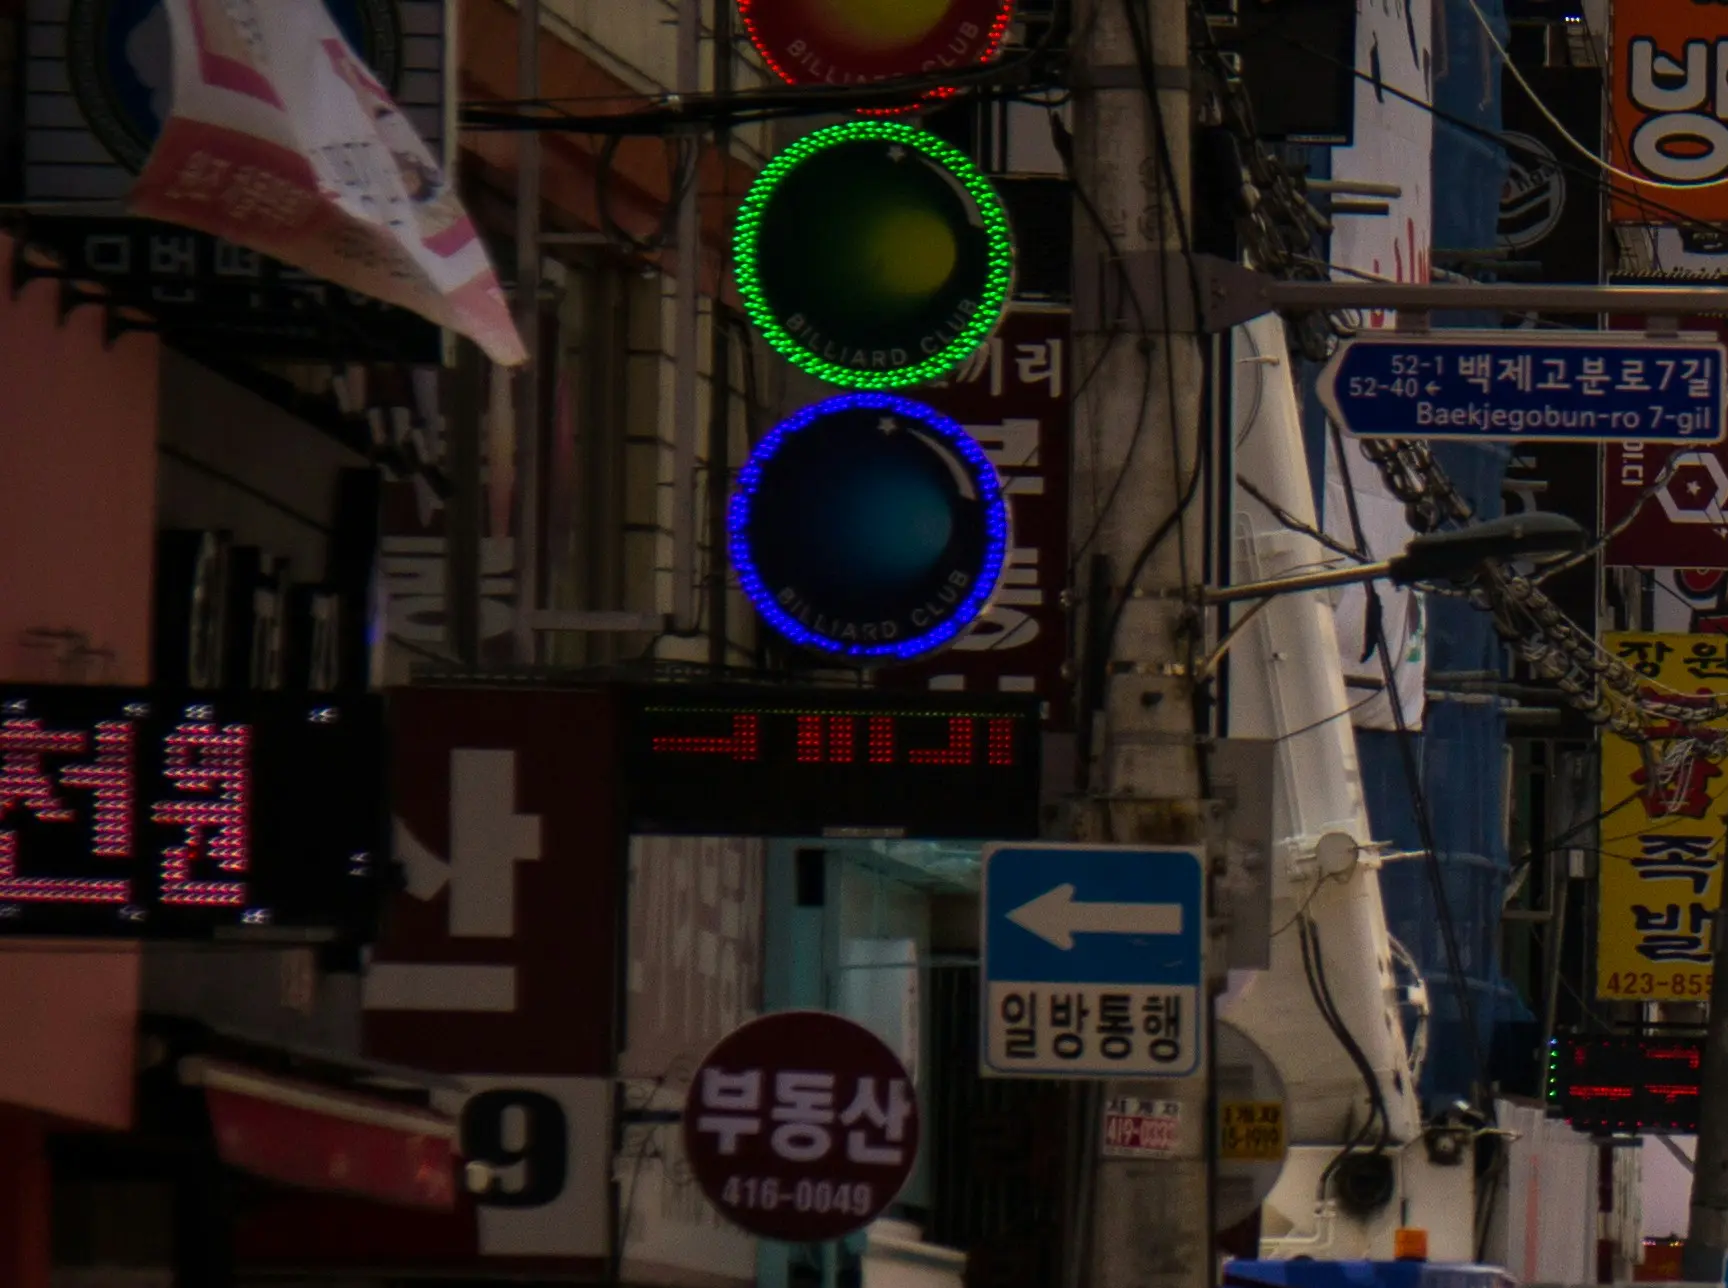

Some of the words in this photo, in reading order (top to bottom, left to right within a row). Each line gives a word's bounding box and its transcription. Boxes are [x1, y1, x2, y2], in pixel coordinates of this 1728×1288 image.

[785, 311, 910, 369] BILLIARD
[918, 296, 982, 358] CLUB
[1349, 377, 1420, 398] 52-40
[1391, 355, 1444, 375] 52-1
[1457, 353, 1712, 398] 백제고분로7길
[1416, 402, 1641, 435] Baekjegobun-ro
[1648, 404, 1712, 435] 7-gil
[774, 586, 898, 642] BILLIARD
[909, 568, 970, 630] CLUB
[999, 990, 1185, 1065] 일방통행
[694, 1064, 912, 1165] 부동산
[721, 1175, 874, 1218] 416-0049
